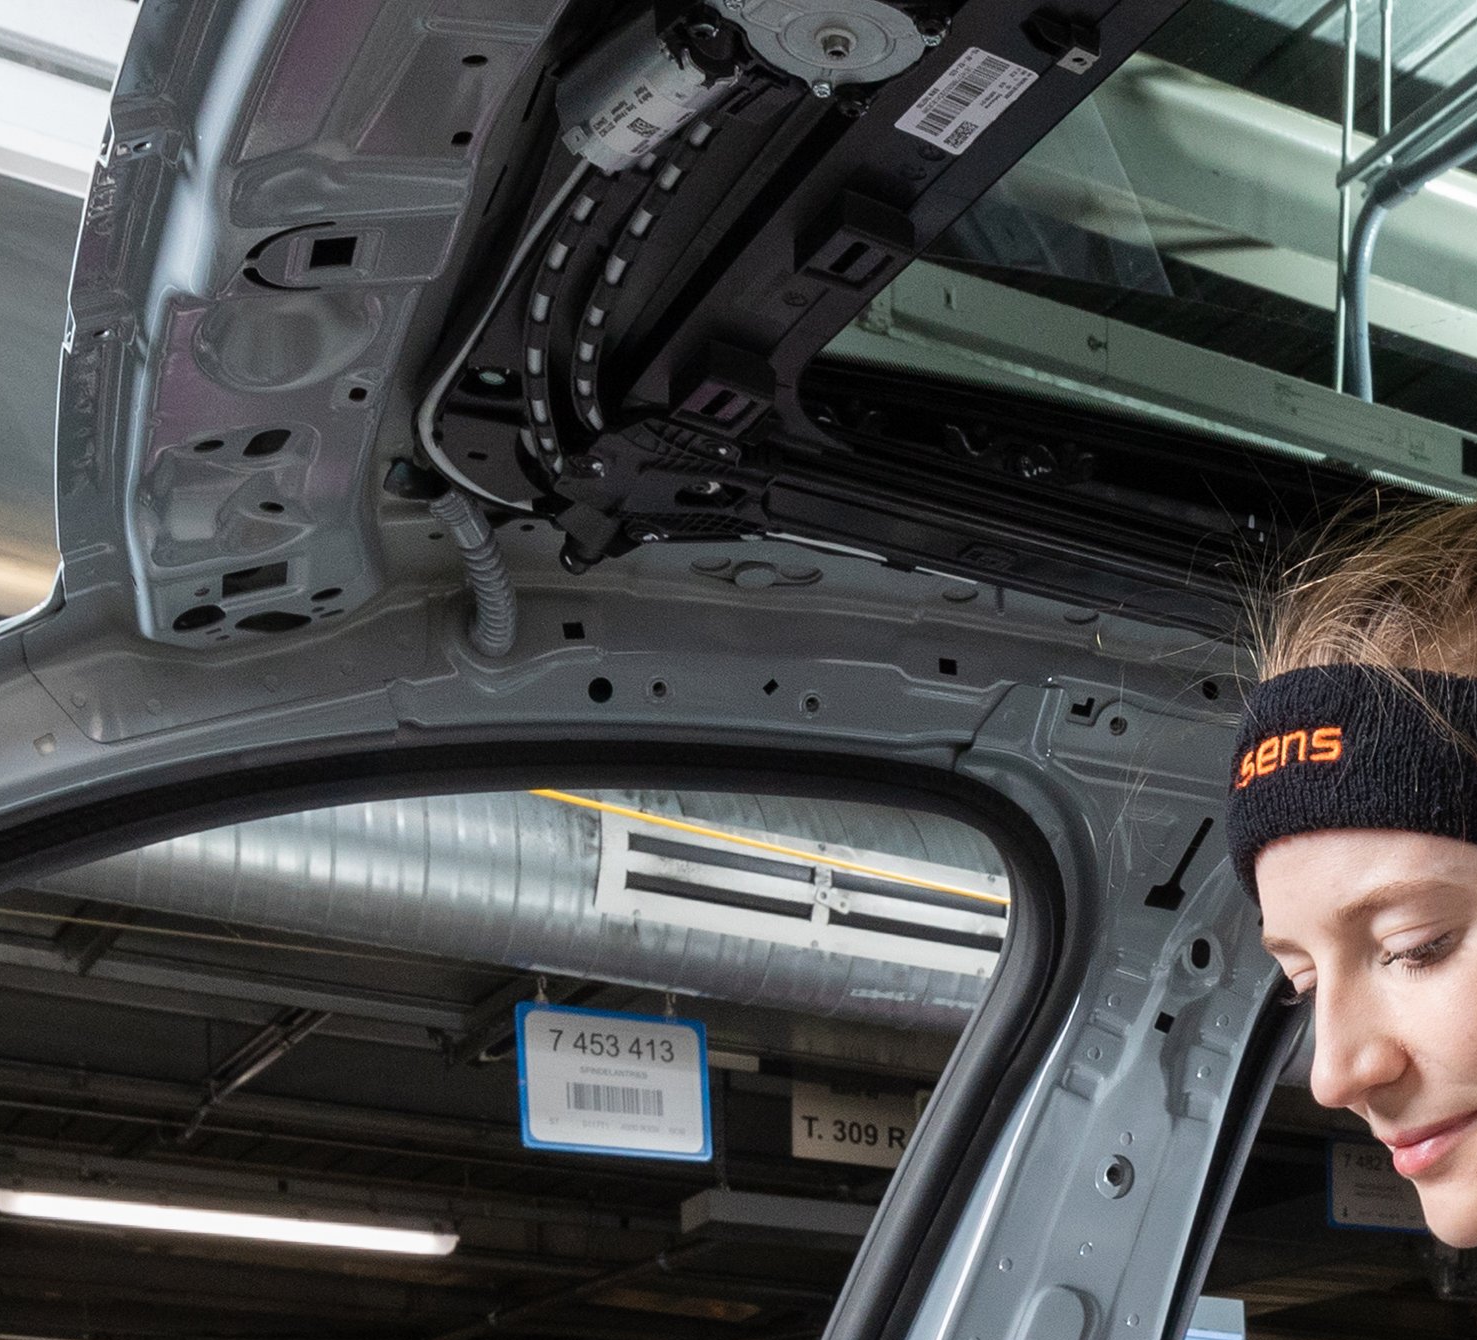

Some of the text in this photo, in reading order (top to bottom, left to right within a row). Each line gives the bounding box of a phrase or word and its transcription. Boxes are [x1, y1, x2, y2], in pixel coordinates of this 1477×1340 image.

[1235, 727, 1342, 789] sens
[549, 1029, 675, 1062] 7 453 413
[802, 1115, 906, 1148] T. 309 R
